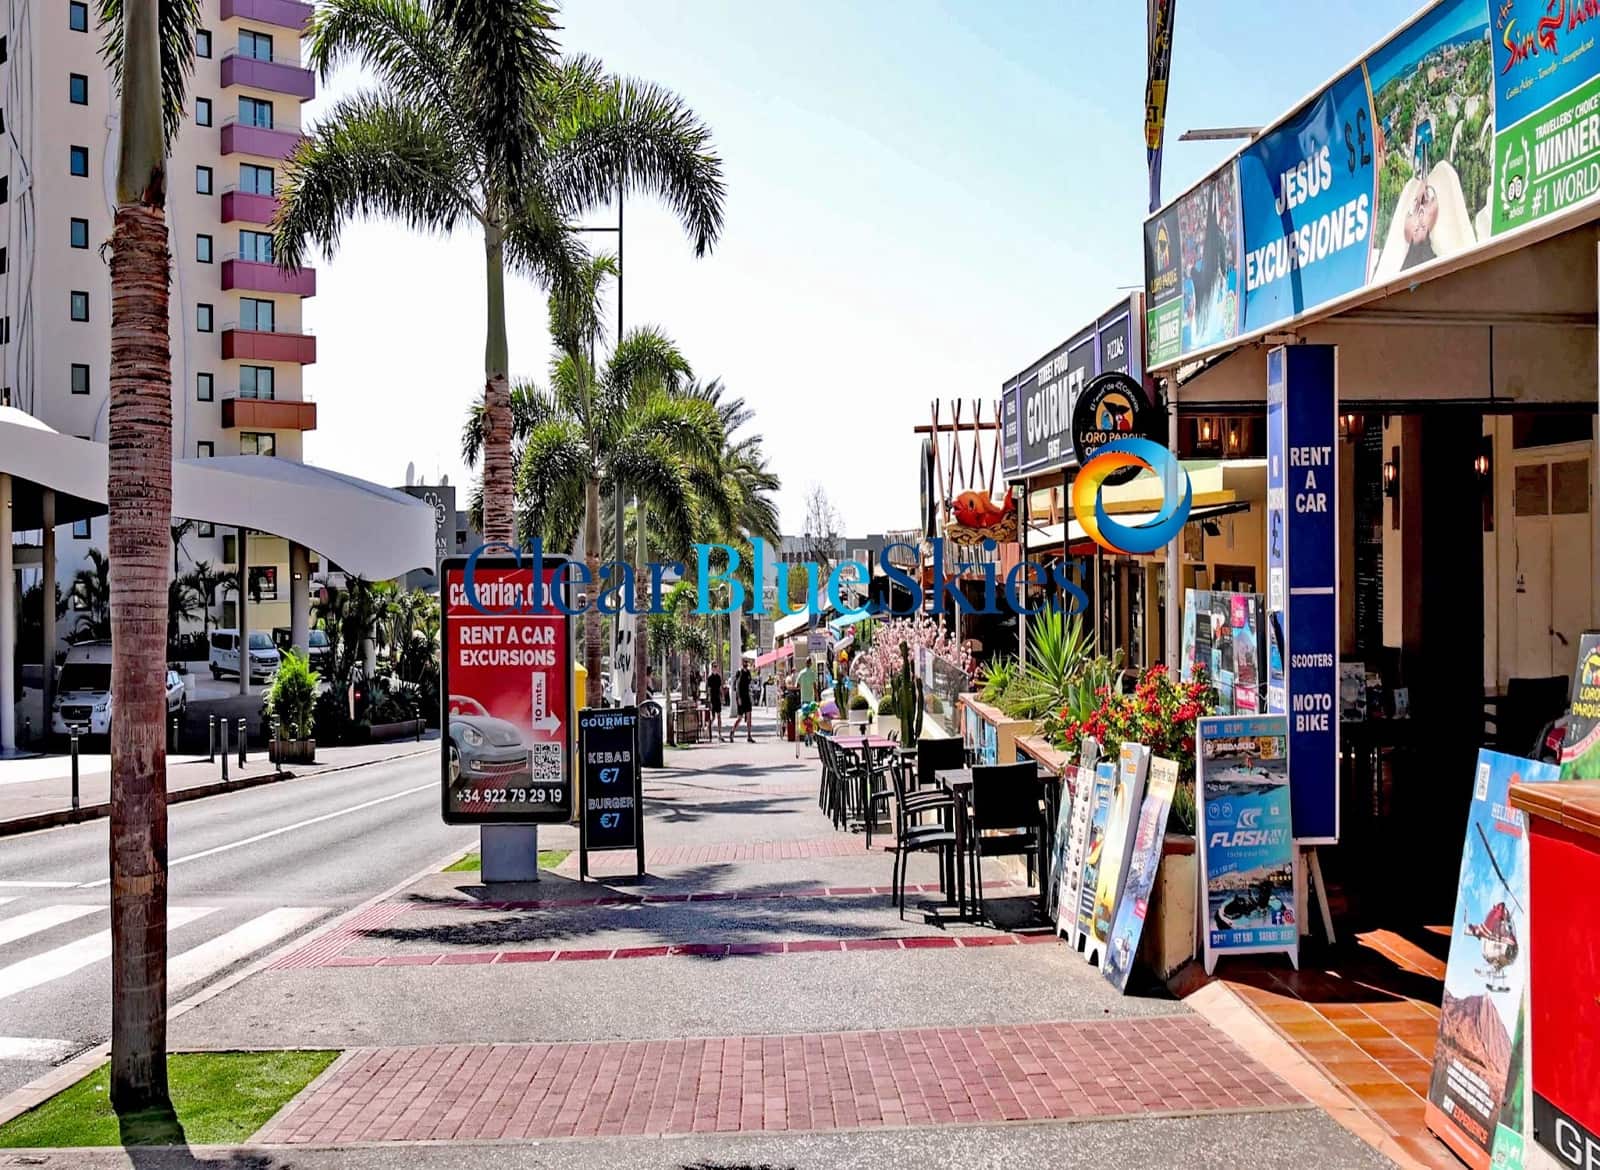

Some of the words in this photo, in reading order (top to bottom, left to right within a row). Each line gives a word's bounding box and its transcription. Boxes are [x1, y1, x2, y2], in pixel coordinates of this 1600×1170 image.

[1534, 114, 1600, 176] WINNER
[1531, 185, 1549, 217] #1
[1552, 163, 1600, 208] WORLD
[1245, 193, 1369, 291] EXCURSIONES
[1107, 336, 1125, 361] PIZZAS
[1026, 366, 1086, 446] GOURMET
[1080, 431, 1107, 444] LORO
[1290, 447, 1331, 466] RENT
[1305, 471, 1317, 490] A
[1295, 493, 1327, 513] CAR
[460, 627, 504, 645] RENT
[507, 627, 520, 645] A
[522, 626, 556, 645] CAR
[460, 649, 556, 666] EXCURSIONS
[1291, 653, 1333, 668] SCOOTERS
[1293, 694, 1332, 712] MOTO
[535, 708, 542, 722] 10
[581, 716, 637, 728] GOURMET
[1296, 714, 1329, 732] BIKE
[588, 751, 631, 764] KEBAB
[599, 768, 620, 784] €7
[456, 789, 480, 803] +34
[484, 789, 507, 803] 922
[511, 789, 526, 803] 79
[529, 789, 546, 803] 29
[549, 788, 562, 803] 19
[588, 797, 634, 810] BURGER
[600, 813, 620, 828] €7
[1210, 831, 1267, 848] FLASH
